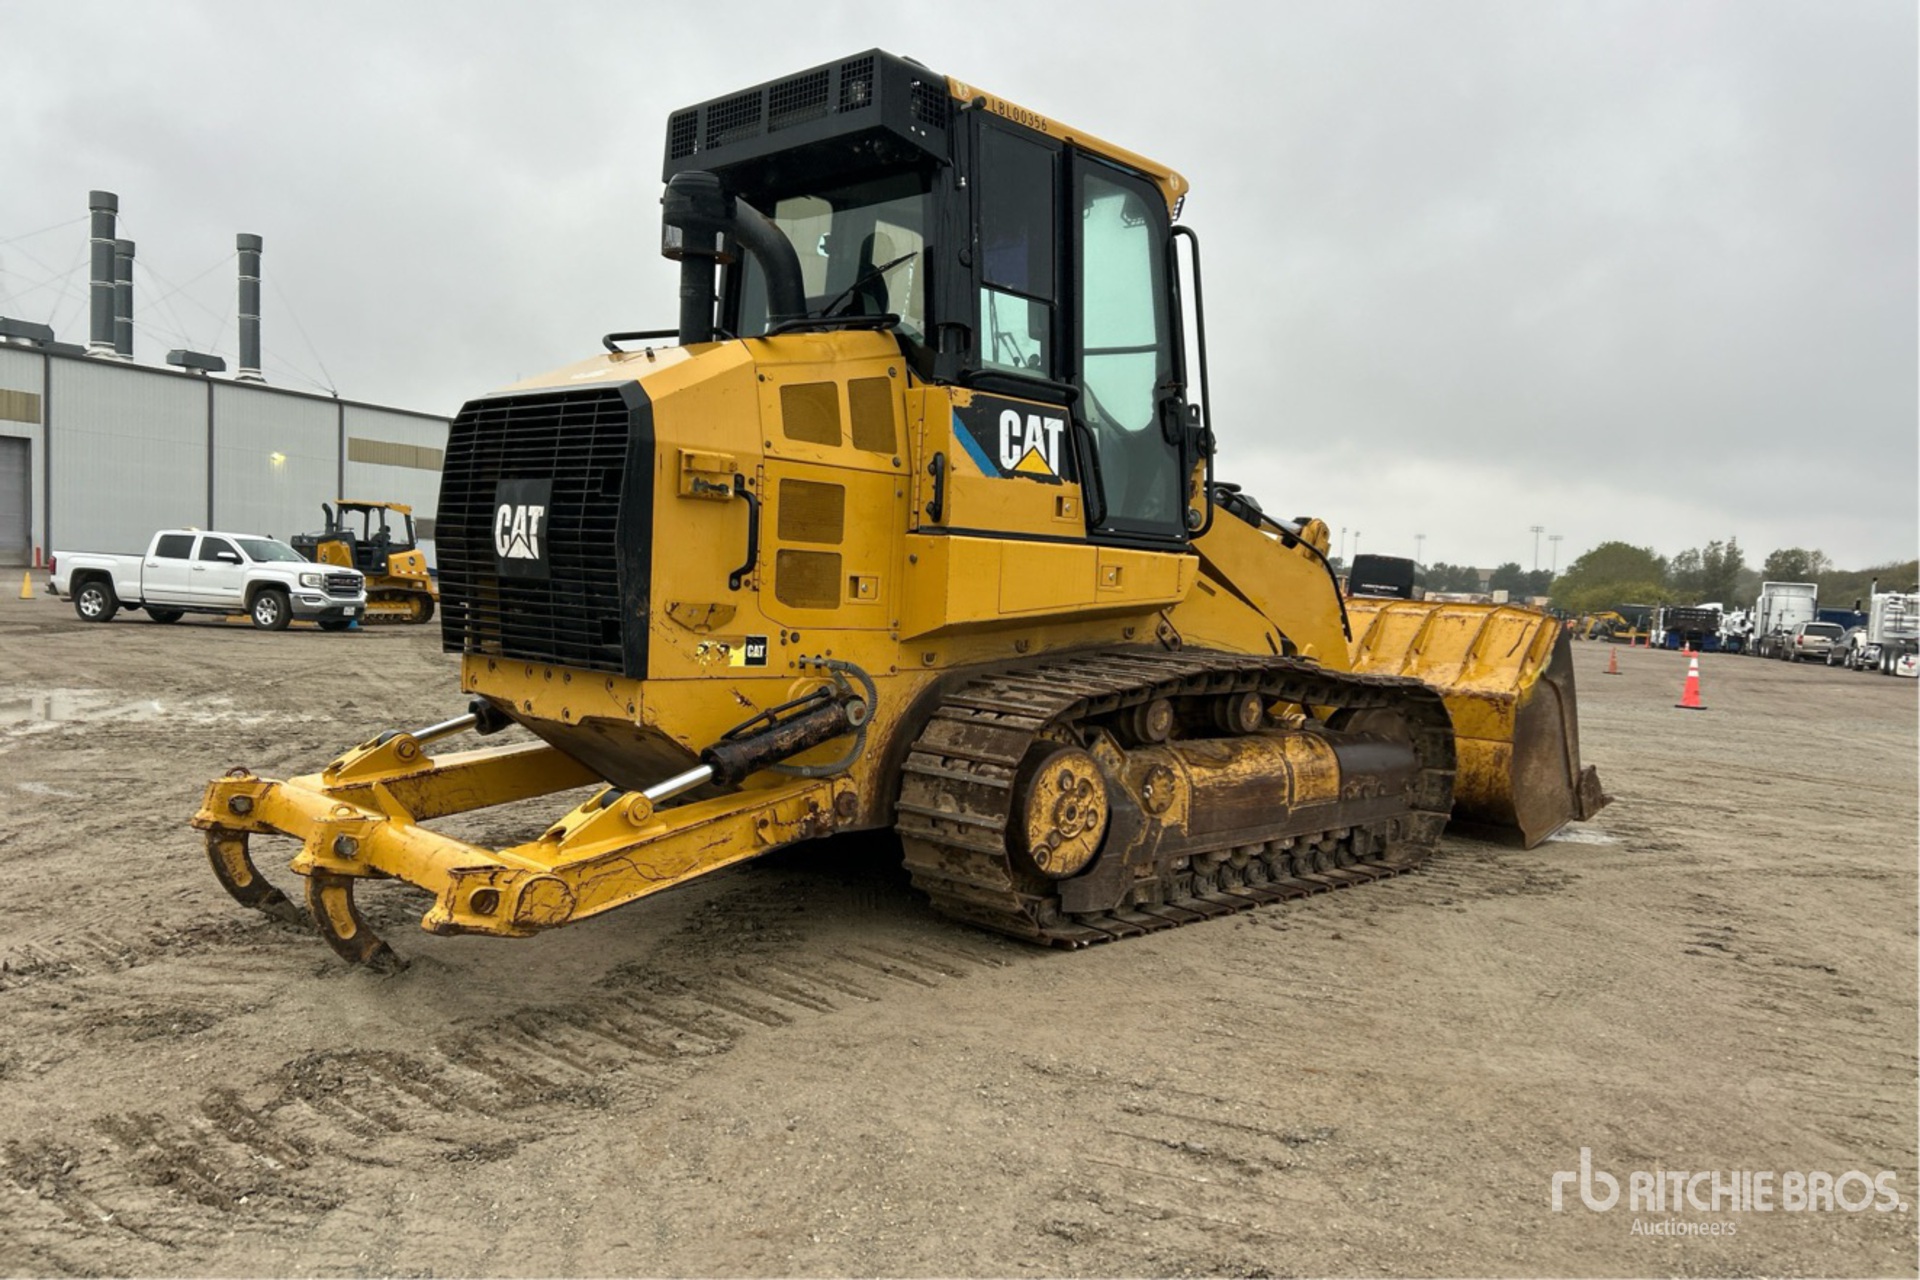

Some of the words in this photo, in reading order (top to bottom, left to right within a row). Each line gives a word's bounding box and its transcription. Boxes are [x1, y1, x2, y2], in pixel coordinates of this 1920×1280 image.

[991, 98, 1048, 131] LBL00356
[999, 409, 1064, 477] CAT
[495, 503, 545, 559] CAT
[747, 644, 765, 658] CAT
